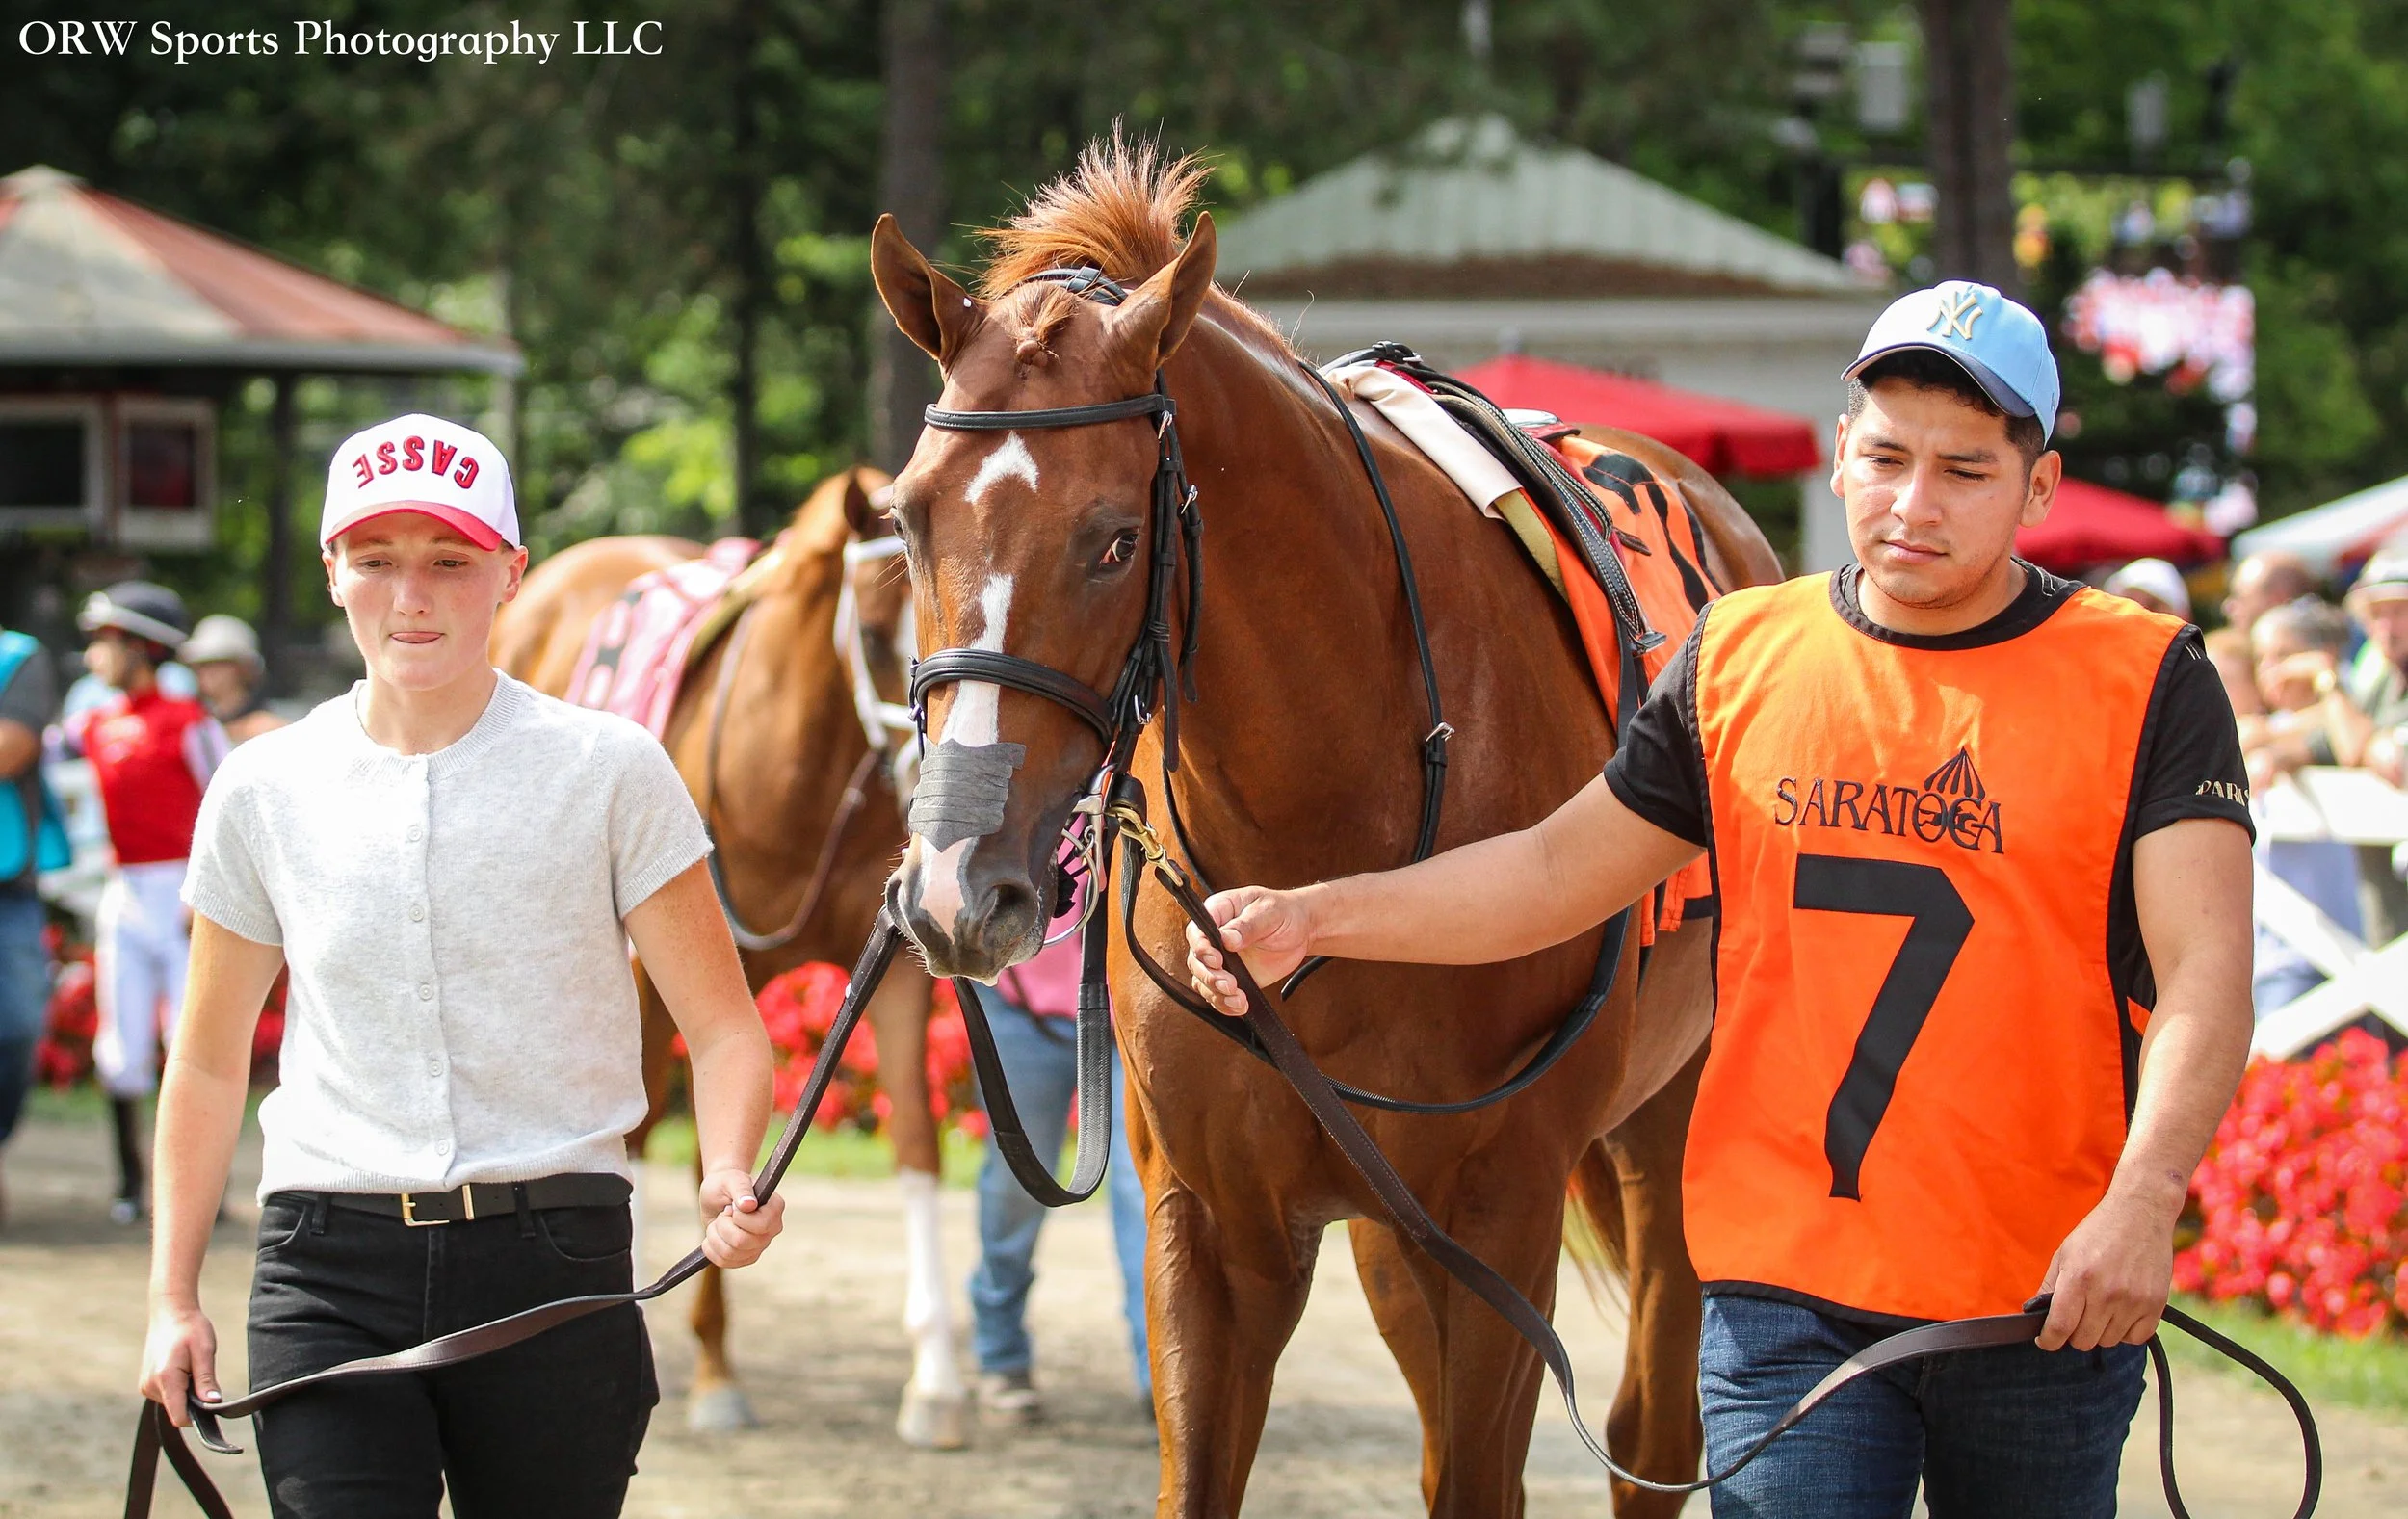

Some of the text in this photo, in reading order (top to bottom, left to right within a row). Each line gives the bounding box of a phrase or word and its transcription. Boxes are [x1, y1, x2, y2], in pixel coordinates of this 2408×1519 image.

[1926, 290, 1983, 340] NY
[353, 435, 480, 489] CASSE
[1774, 777, 2004, 854] SARATOGA
[1793, 852, 1976, 1203] 7
